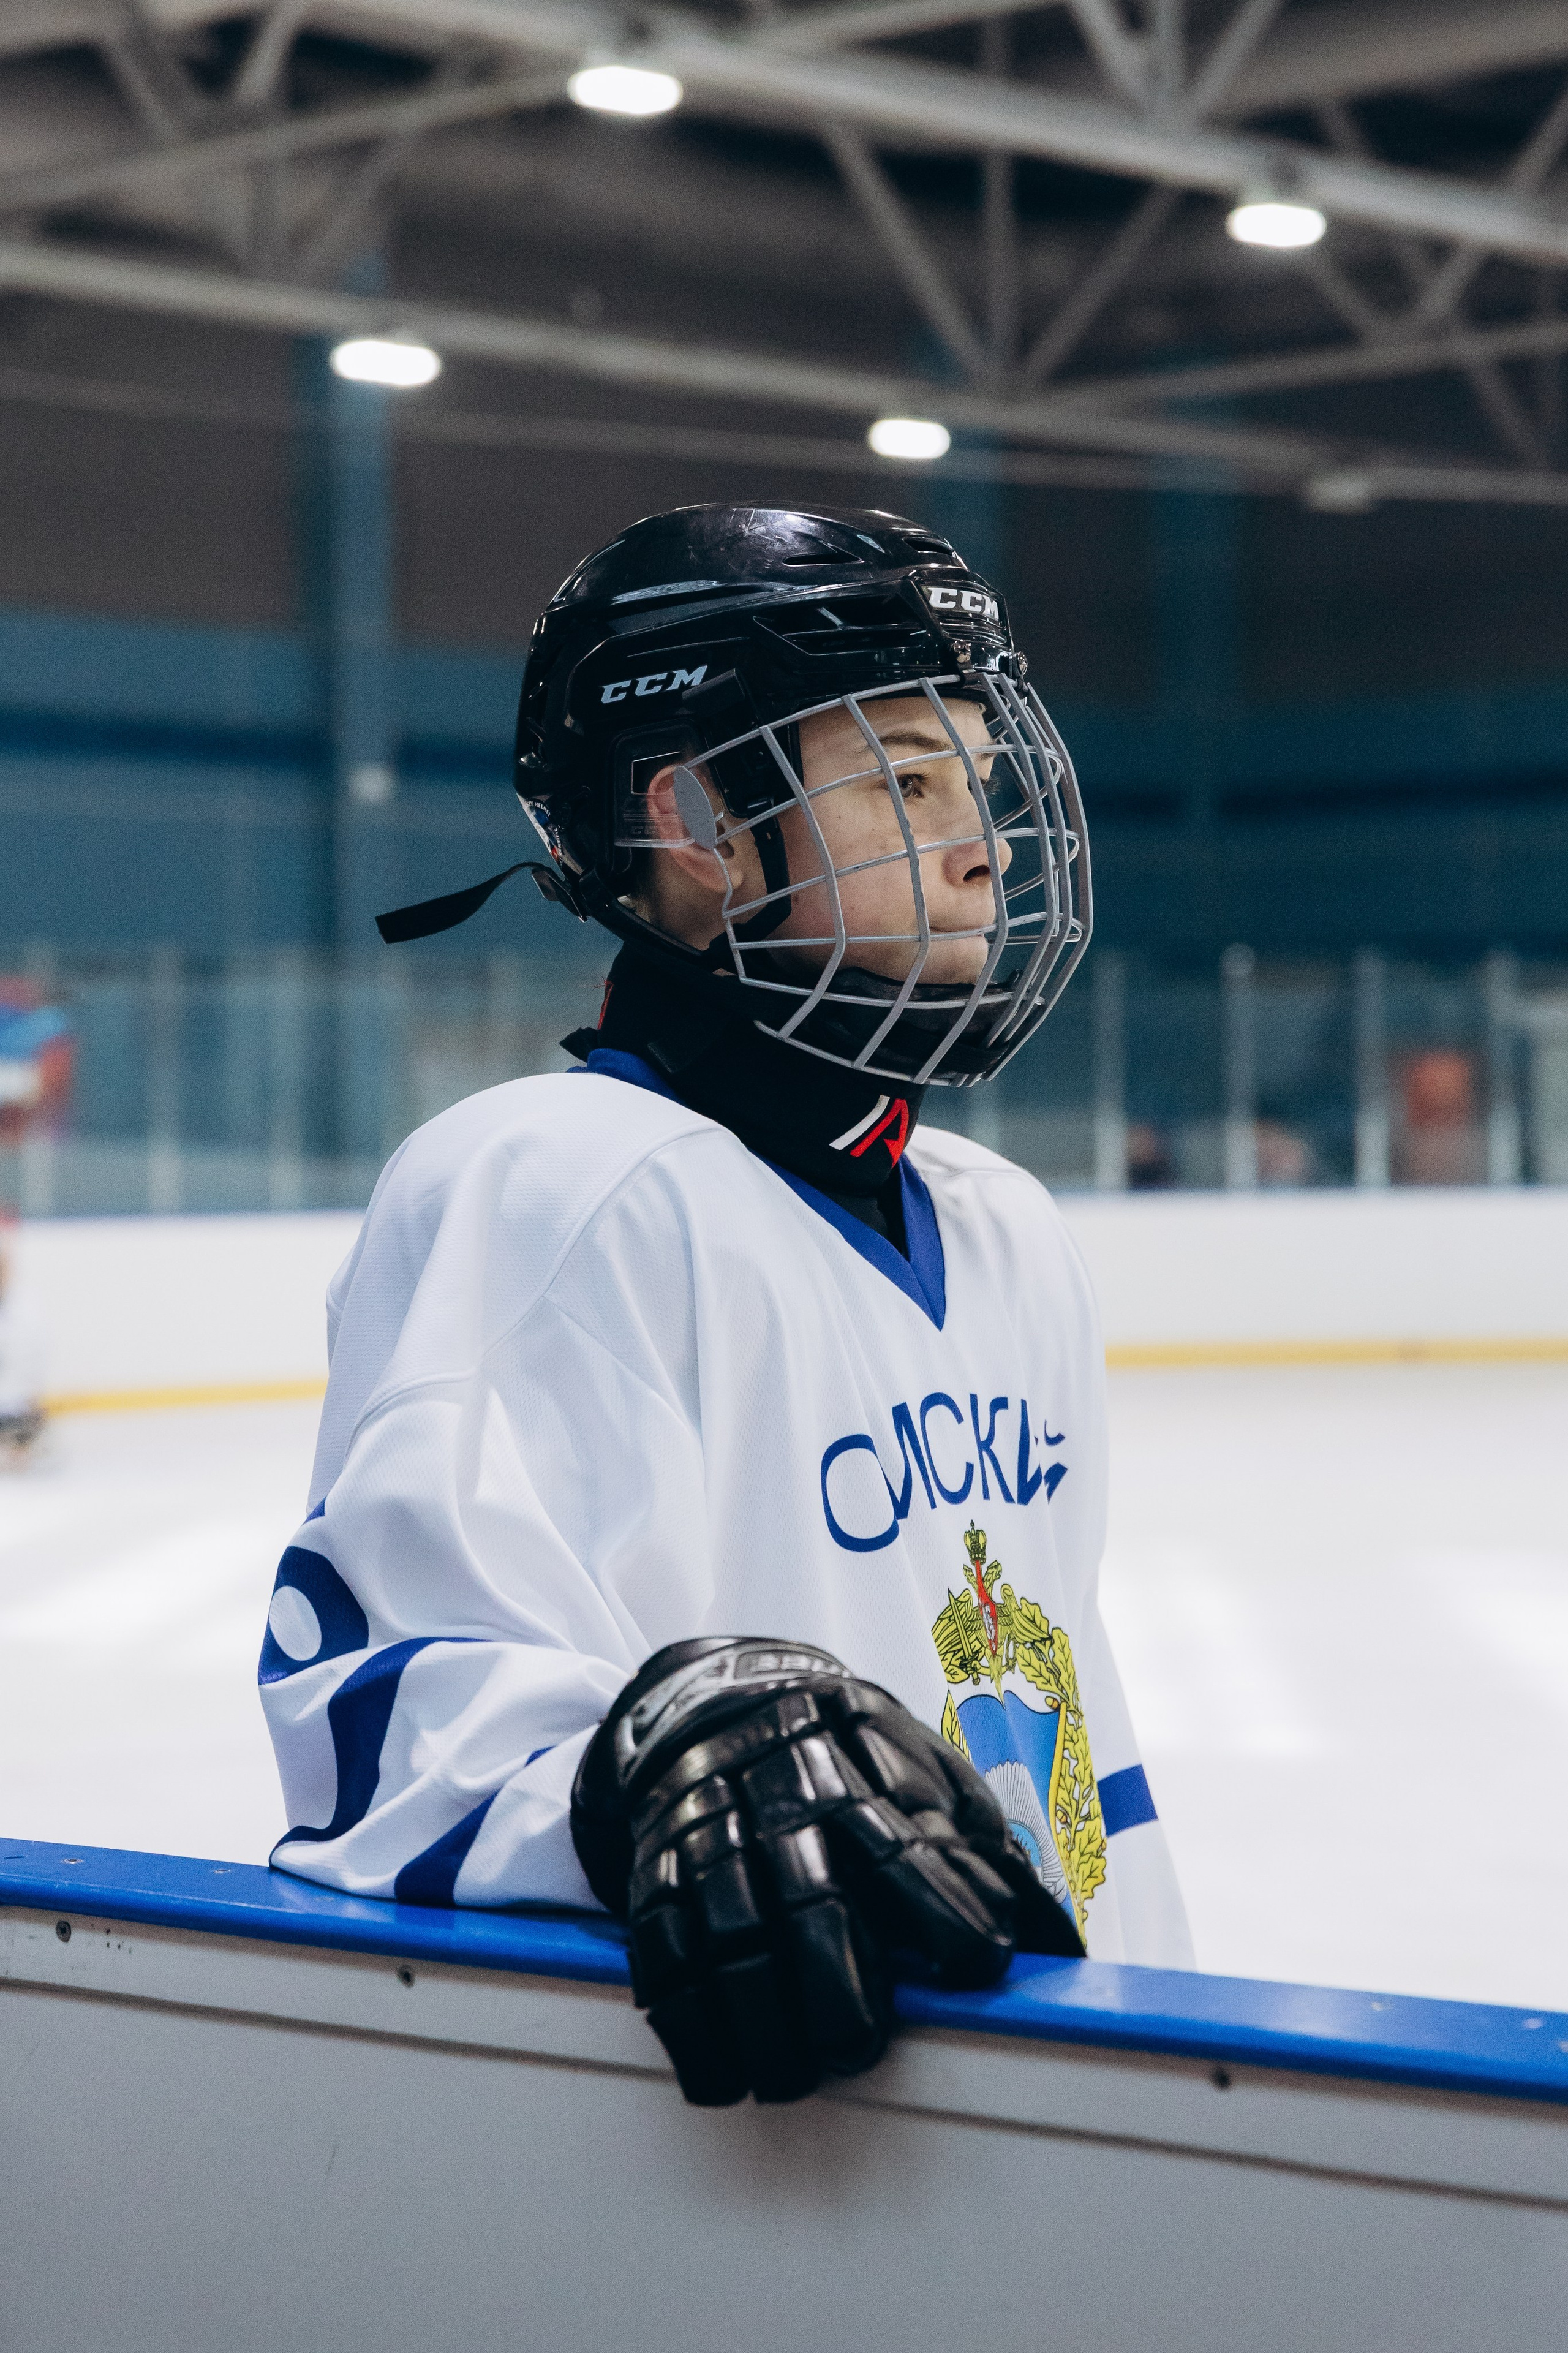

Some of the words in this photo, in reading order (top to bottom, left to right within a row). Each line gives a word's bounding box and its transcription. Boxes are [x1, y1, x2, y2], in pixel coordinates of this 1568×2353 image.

[927, 587, 999, 621] CCM
[601, 665, 708, 704] CCM
[534, 801, 551, 817] HELMET
